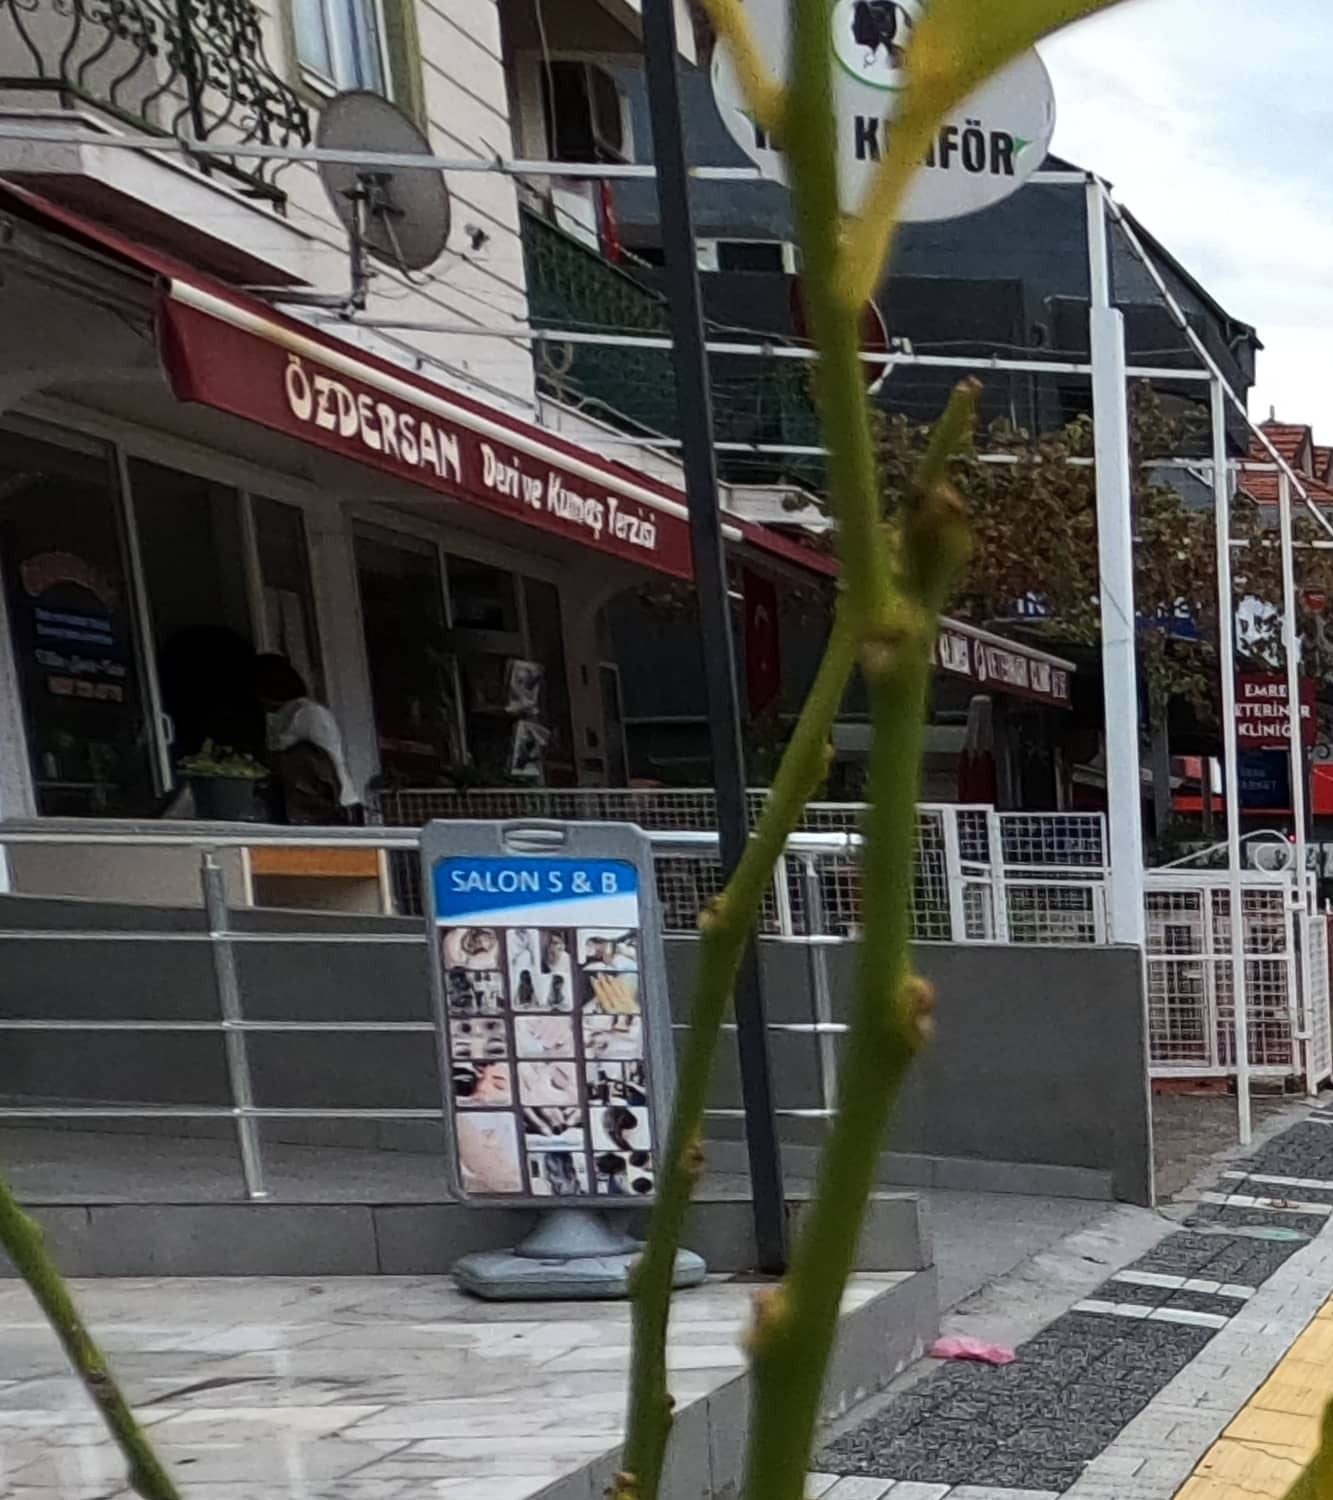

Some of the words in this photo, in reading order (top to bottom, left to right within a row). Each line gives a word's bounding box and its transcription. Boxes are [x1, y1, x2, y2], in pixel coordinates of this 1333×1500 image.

[854, 116, 1015, 176] KFÖR
[285, 352, 462, 484] ÖZDERSAN
[480, 443, 519, 498] Deri
[521, 474, 543, 510] ve
[606, 496, 657, 550] Terzisi
[1244, 683, 1287, 698] EMRE
[1232, 701, 1311, 719] ETERİNR
[451, 870, 540, 893] SALON
[548, 871, 563, 893] S
[571, 871, 593, 894] &
[601, 872, 617, 893] B
